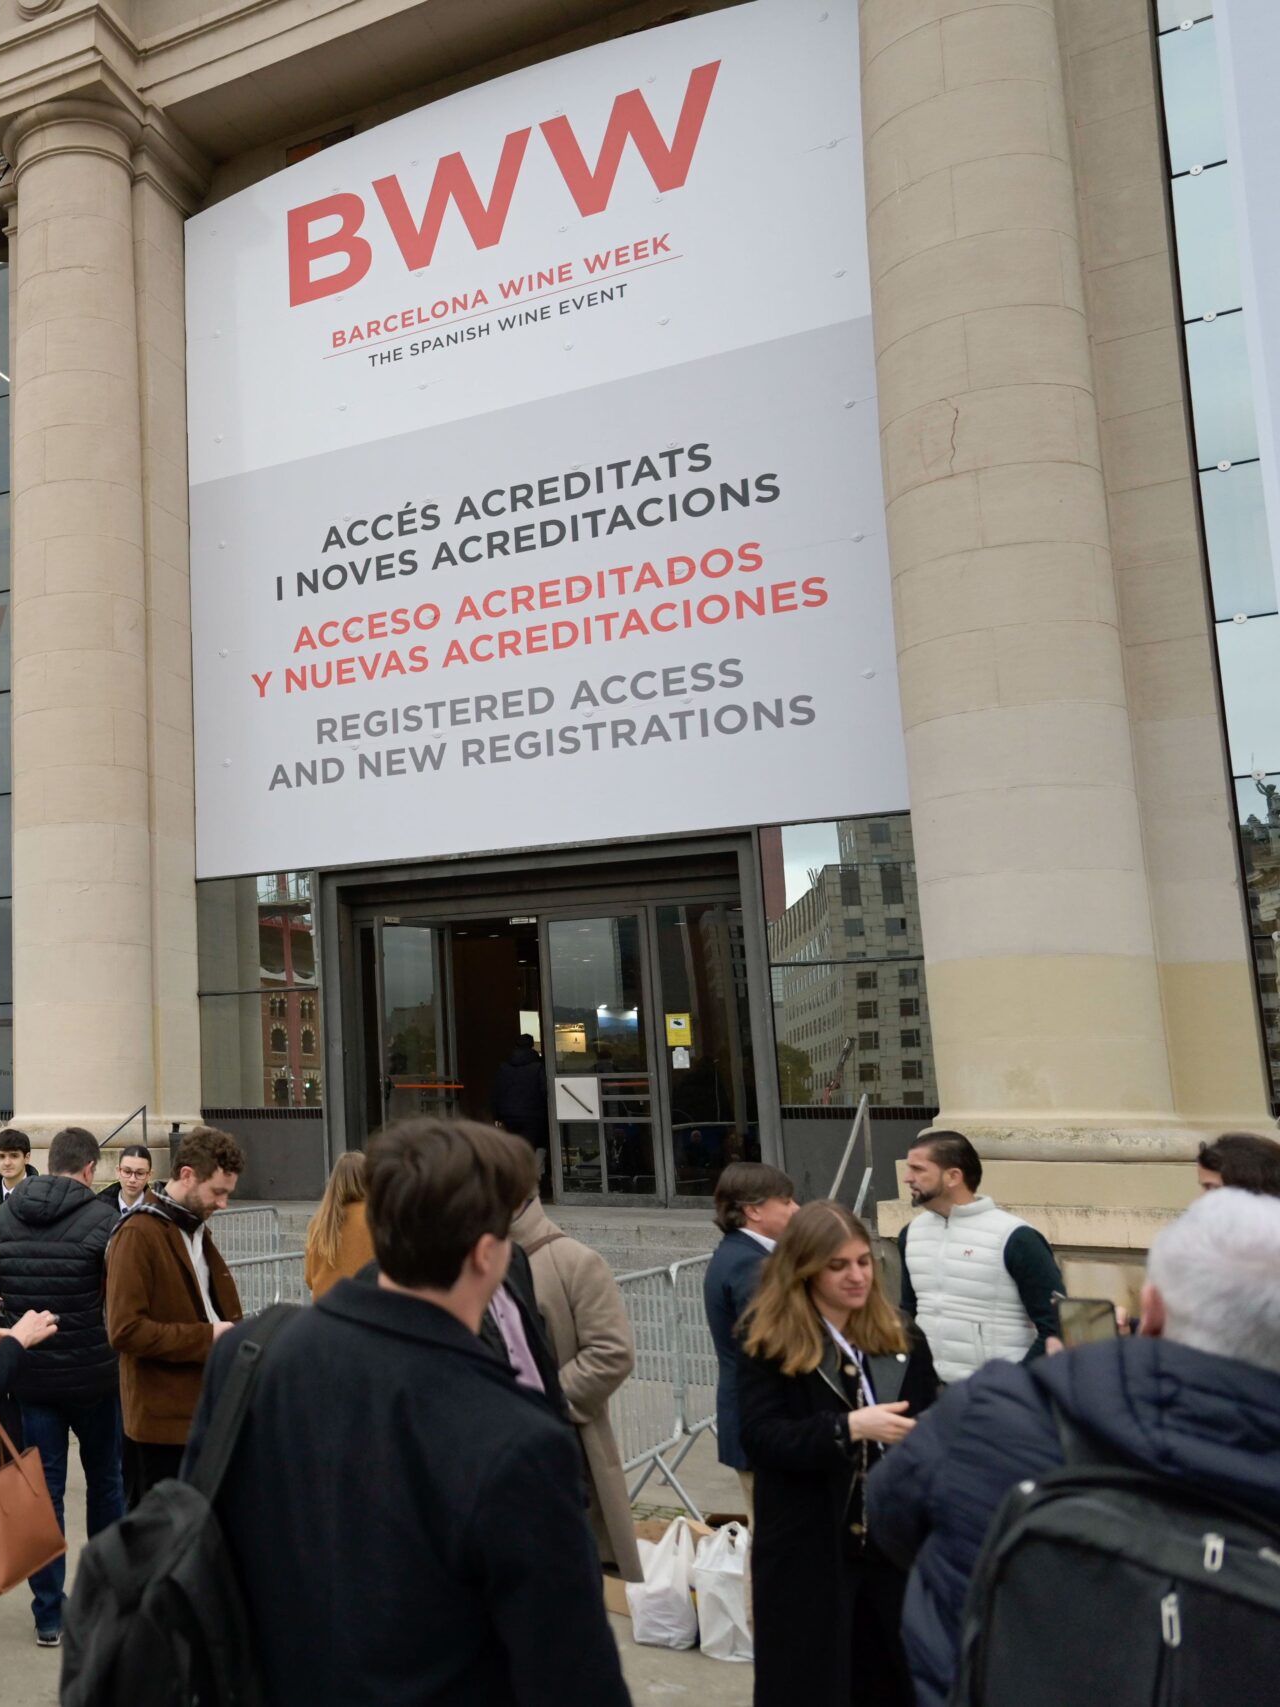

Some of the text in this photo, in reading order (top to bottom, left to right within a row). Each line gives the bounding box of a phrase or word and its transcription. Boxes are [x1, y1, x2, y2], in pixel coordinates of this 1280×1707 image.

[287, 59, 721, 307] BWW
[333, 233, 671, 348] BARCELONA WINE WEEK
[369, 284, 627, 368] THE SPANISH WINE EVENT
[277, 473, 780, 601] I NOVES ACREDITACIONS
[321, 443, 712, 553] ACCÉS ACREDITATS
[251, 577, 828, 698] Y NUEVAS ACREDITACIONES
[294, 542, 763, 653] ACCESO ACREDITADOS
[269, 695, 815, 791] AND NEW REGISTRATIONS
[317, 658, 744, 746] REGISTERED ACCESS
